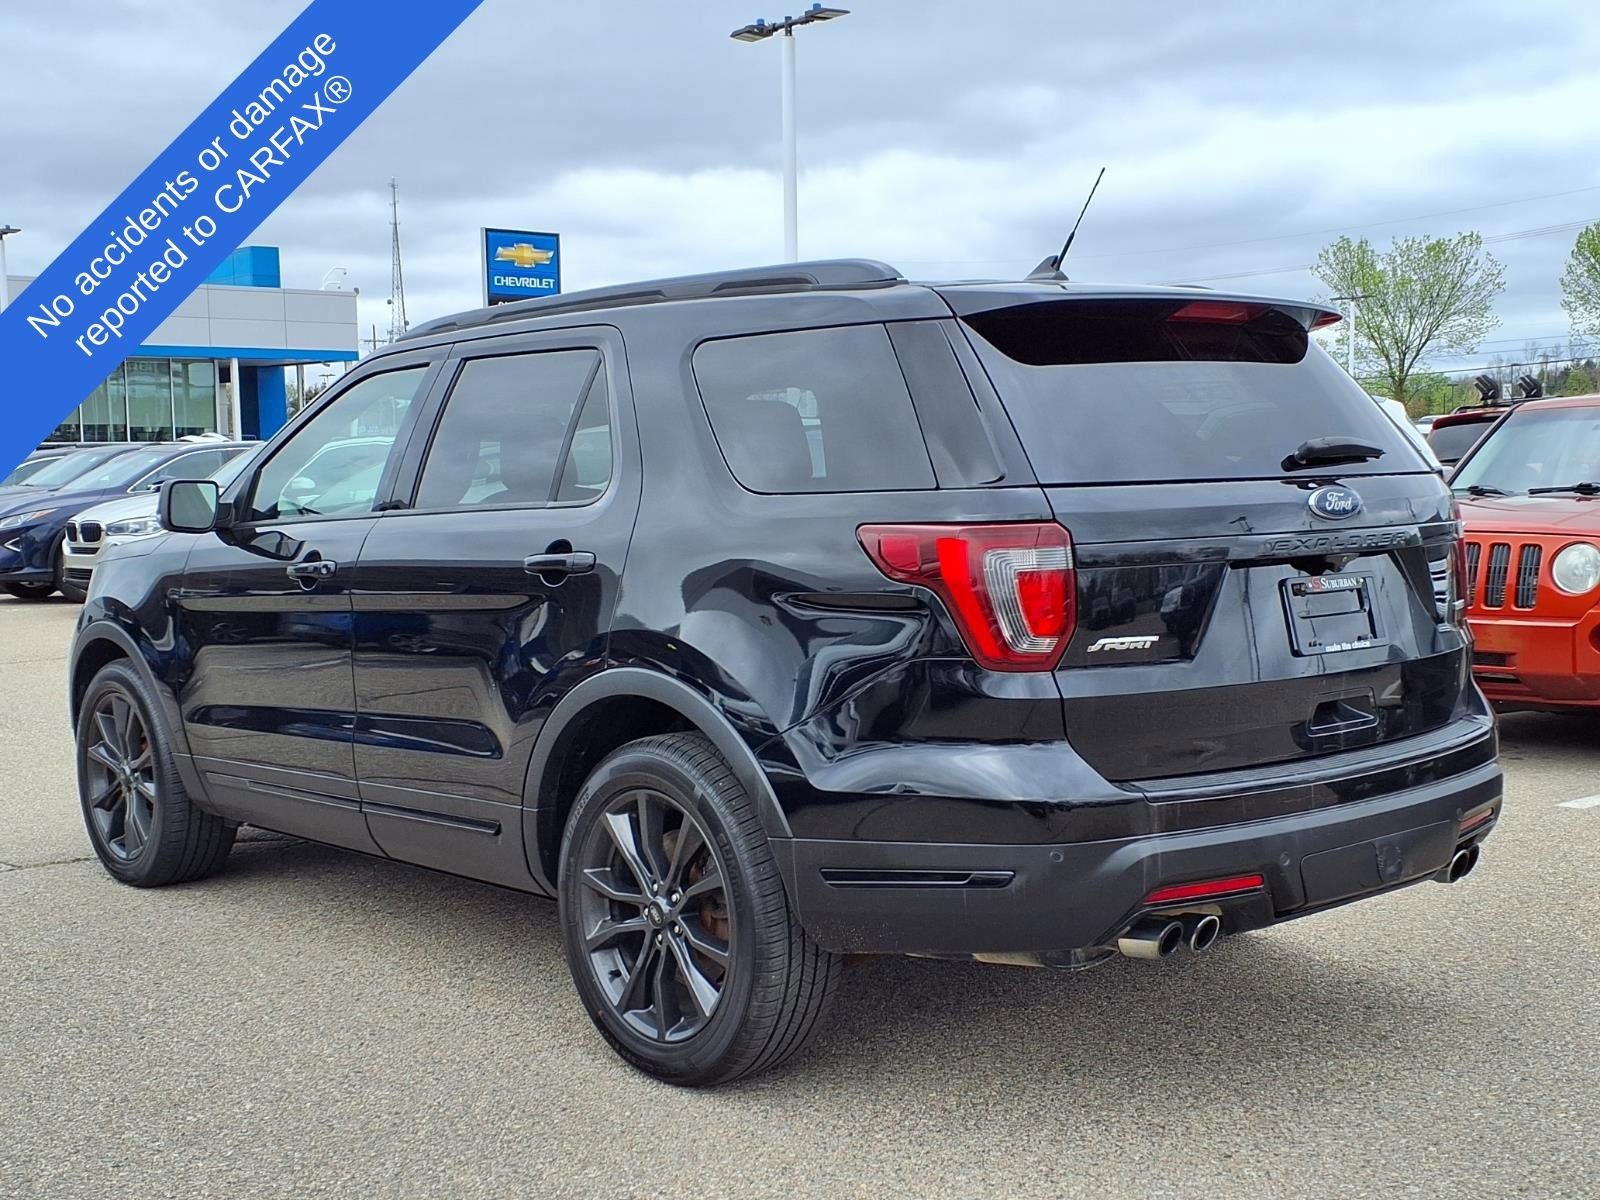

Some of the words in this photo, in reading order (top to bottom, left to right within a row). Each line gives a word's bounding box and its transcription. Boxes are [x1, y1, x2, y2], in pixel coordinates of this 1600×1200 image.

[494, 275, 555, 289] CHEVROLET
[1325, 491, 1353, 511] Ford
[1269, 530, 1408, 552] EXPLORER
[1087, 635, 1160, 653] SPORT
